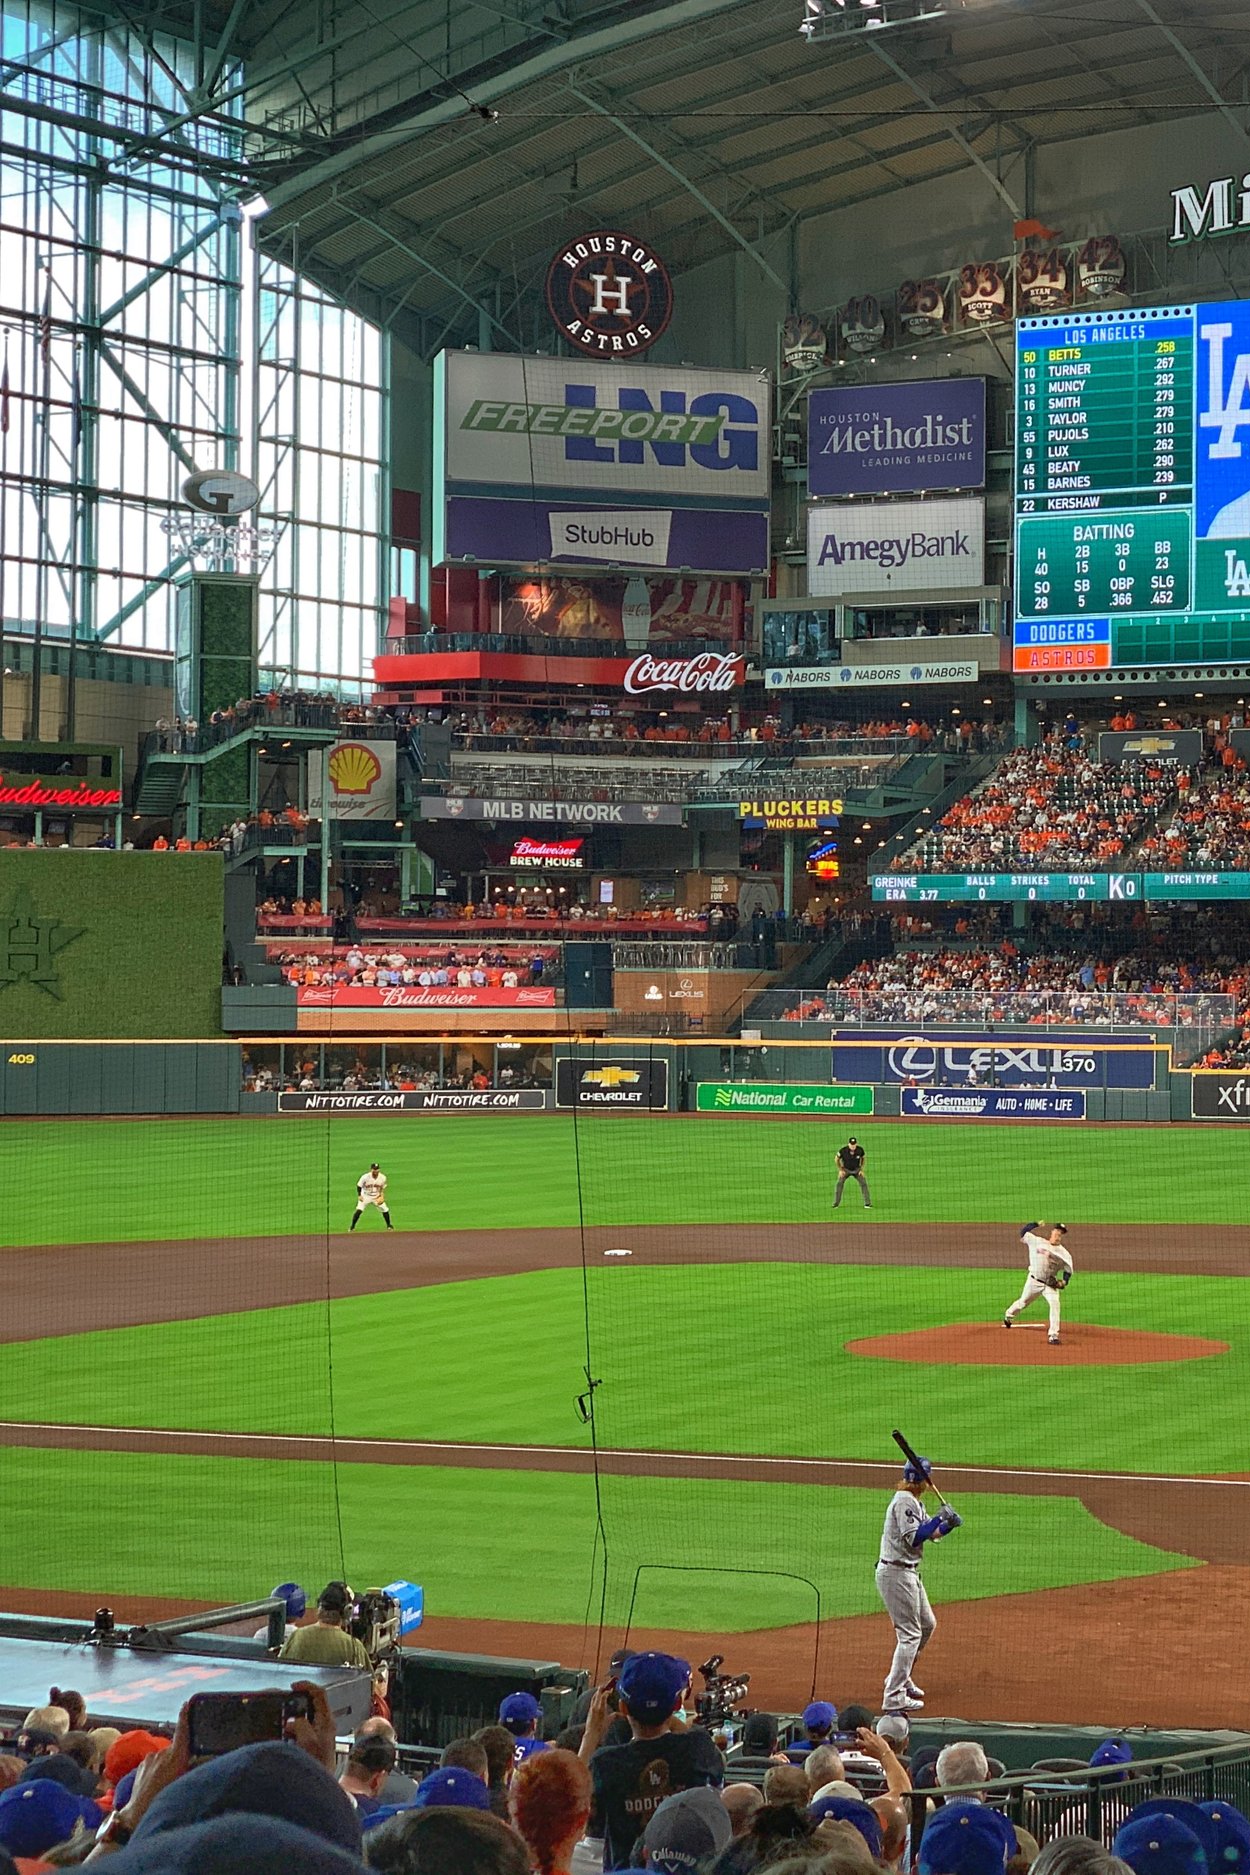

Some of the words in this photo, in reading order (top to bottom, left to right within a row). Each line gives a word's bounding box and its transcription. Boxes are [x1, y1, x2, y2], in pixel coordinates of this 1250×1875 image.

[562, 236, 658, 275] HOUSTON
[1082, 275, 1120, 287] ROBINSON
[1030, 288, 1051, 296] RYAN
[967, 302, 993, 312] SCOTT
[566, 319, 652, 350] ASTROS
[1065, 330, 1087, 344] LOS
[1092, 324, 1145, 342] ANGELES
[1048, 348, 1081, 361] BETTS
[1048, 363, 1091, 377] TURNER
[1048, 380, 1086, 393] MUNCY
[1048, 396, 1081, 409] SMITH
[469, 402, 716, 442] FREEPORT
[819, 412, 880, 425] HOUSTON
[1048, 412, 1087, 425] TAYLOR
[564, 384, 758, 471] LNG
[819, 414, 973, 455] Methodist
[1048, 428, 1089, 441] PUJOLS
[1048, 445, 1069, 457] LUX
[861, 455, 911, 468] LEADING
[916, 451, 973, 464] MEDICINE
[1048, 461, 1080, 473] BEATY
[1048, 476, 1090, 489] BARNES
[1048, 496, 1100, 510] KERSHAW
[565, 524, 654, 547] StubHub
[1073, 523, 1135, 541] BATTING
[817, 529, 970, 567] AmegyBank
[1030, 622, 1095, 642] DODGERS
[1030, 649, 1095, 666] ASTROS
[623, 652, 744, 694] Coca-Cola
[785, 671, 831, 684] NABORS
[854, 669, 901, 681] NABORS
[924, 666, 972, 678] NABORS
[483, 801, 524, 818] MLB
[529, 803, 623, 821] NETWORK
[740, 799, 843, 817] PLUCKERS
[766, 818, 794, 828] WING
[796, 818, 817, 828] BAR
[513, 840, 576, 856] Budweiser
[510, 856, 542, 866] BREW
[544, 857, 583, 867] HOUSE
[1164, 874, 1193, 884] PITCH
[1195, 874, 1218, 884] TYPE
[875, 877, 917, 888] GREINKE
[966, 876, 996, 885] BALLS
[1011, 875, 1049, 885] STRIKES
[1068, 875, 1096, 885] TOTAL
[1109, 876, 1124, 899] K
[885, 890, 907, 900] ERA
[919, 890, 939, 900] 3.77
[379, 987, 478, 1006] Budweiser
[669, 990, 704, 998] LEXUS
[8, 1053, 35, 1064] 409
[1062, 1058, 1095, 1072] 370
[305, 1093, 405, 1109] NITTOTIRE.COM
[423, 1092, 520, 1108] NITTOTIRE.COM
[579, 1091, 643, 1102] CHEVROLET
[729, 1089, 787, 1107] National
[792, 1095, 815, 1107] Car
[817, 1094, 856, 1109] Rental
[933, 1093, 987, 1106] Germania
[995, 1098, 1016, 1110] AUTO
[1024, 1098, 1048, 1111] HOME
[1054, 1098, 1073, 1111] LIFE
[651, 1847, 697, 1867] Callaway
